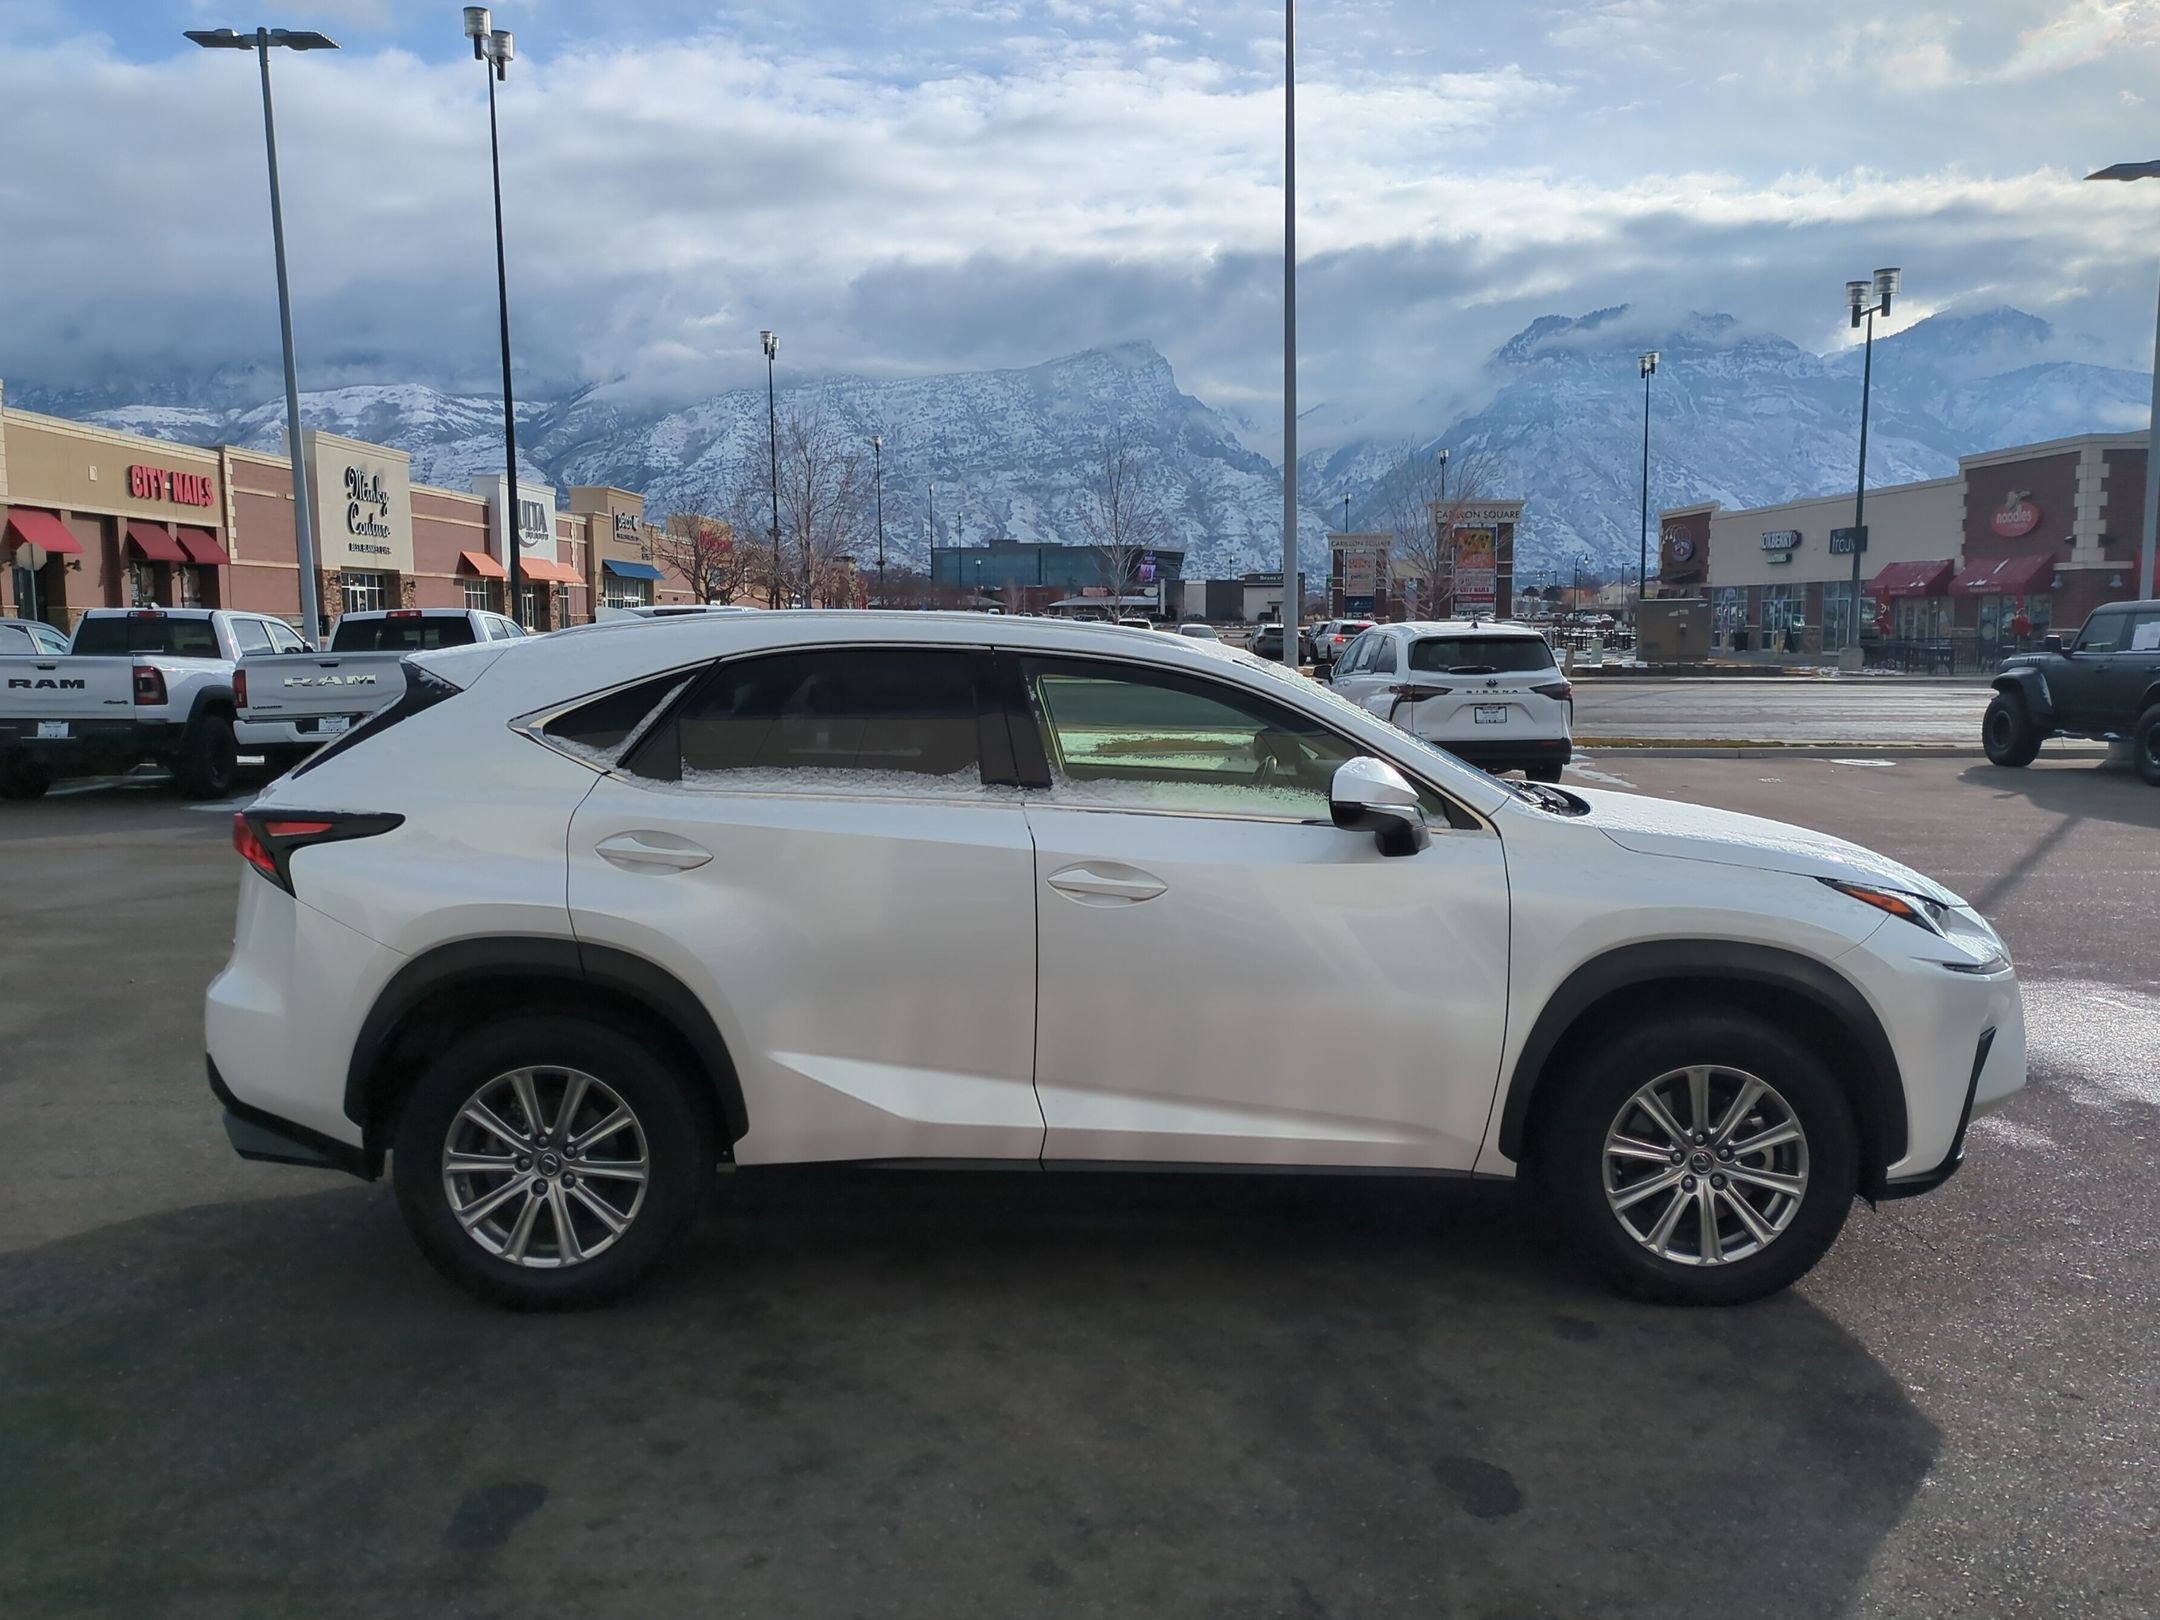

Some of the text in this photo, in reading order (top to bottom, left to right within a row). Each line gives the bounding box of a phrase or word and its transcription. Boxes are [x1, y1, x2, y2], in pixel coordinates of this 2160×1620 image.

[129, 465, 214, 507] CITY NAILS
[344, 465, 390, 517] Minky
[347, 501, 391, 537] Couture
[517, 498, 549, 533] ULTA
[1436, 510, 1520, 519] CALON SQUARE
[1996, 503, 2032, 524] noodles
[8, 679, 85, 689] RAM
[284, 674, 377, 687] RAM
